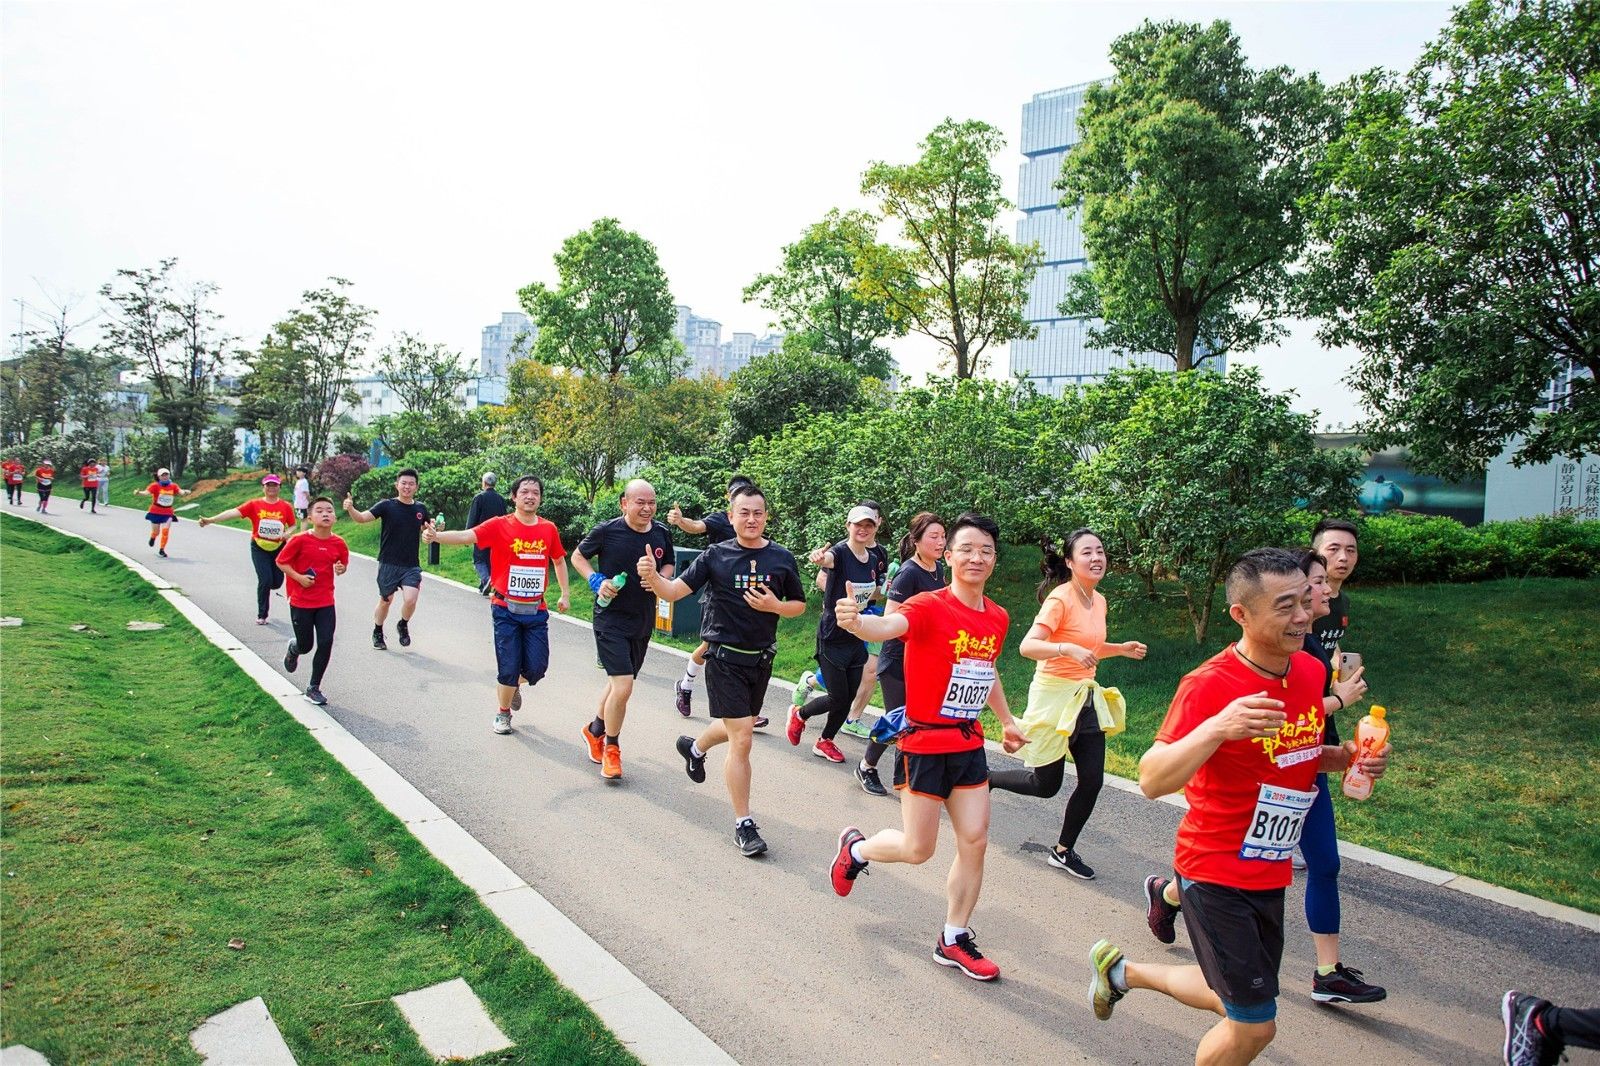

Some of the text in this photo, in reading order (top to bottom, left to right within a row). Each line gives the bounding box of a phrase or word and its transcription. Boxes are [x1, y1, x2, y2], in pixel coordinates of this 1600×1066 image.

[1584, 463, 1600, 519] 心灵释然恬
[510, 576, 540, 589] B10655
[946, 683, 989, 704] B10373
